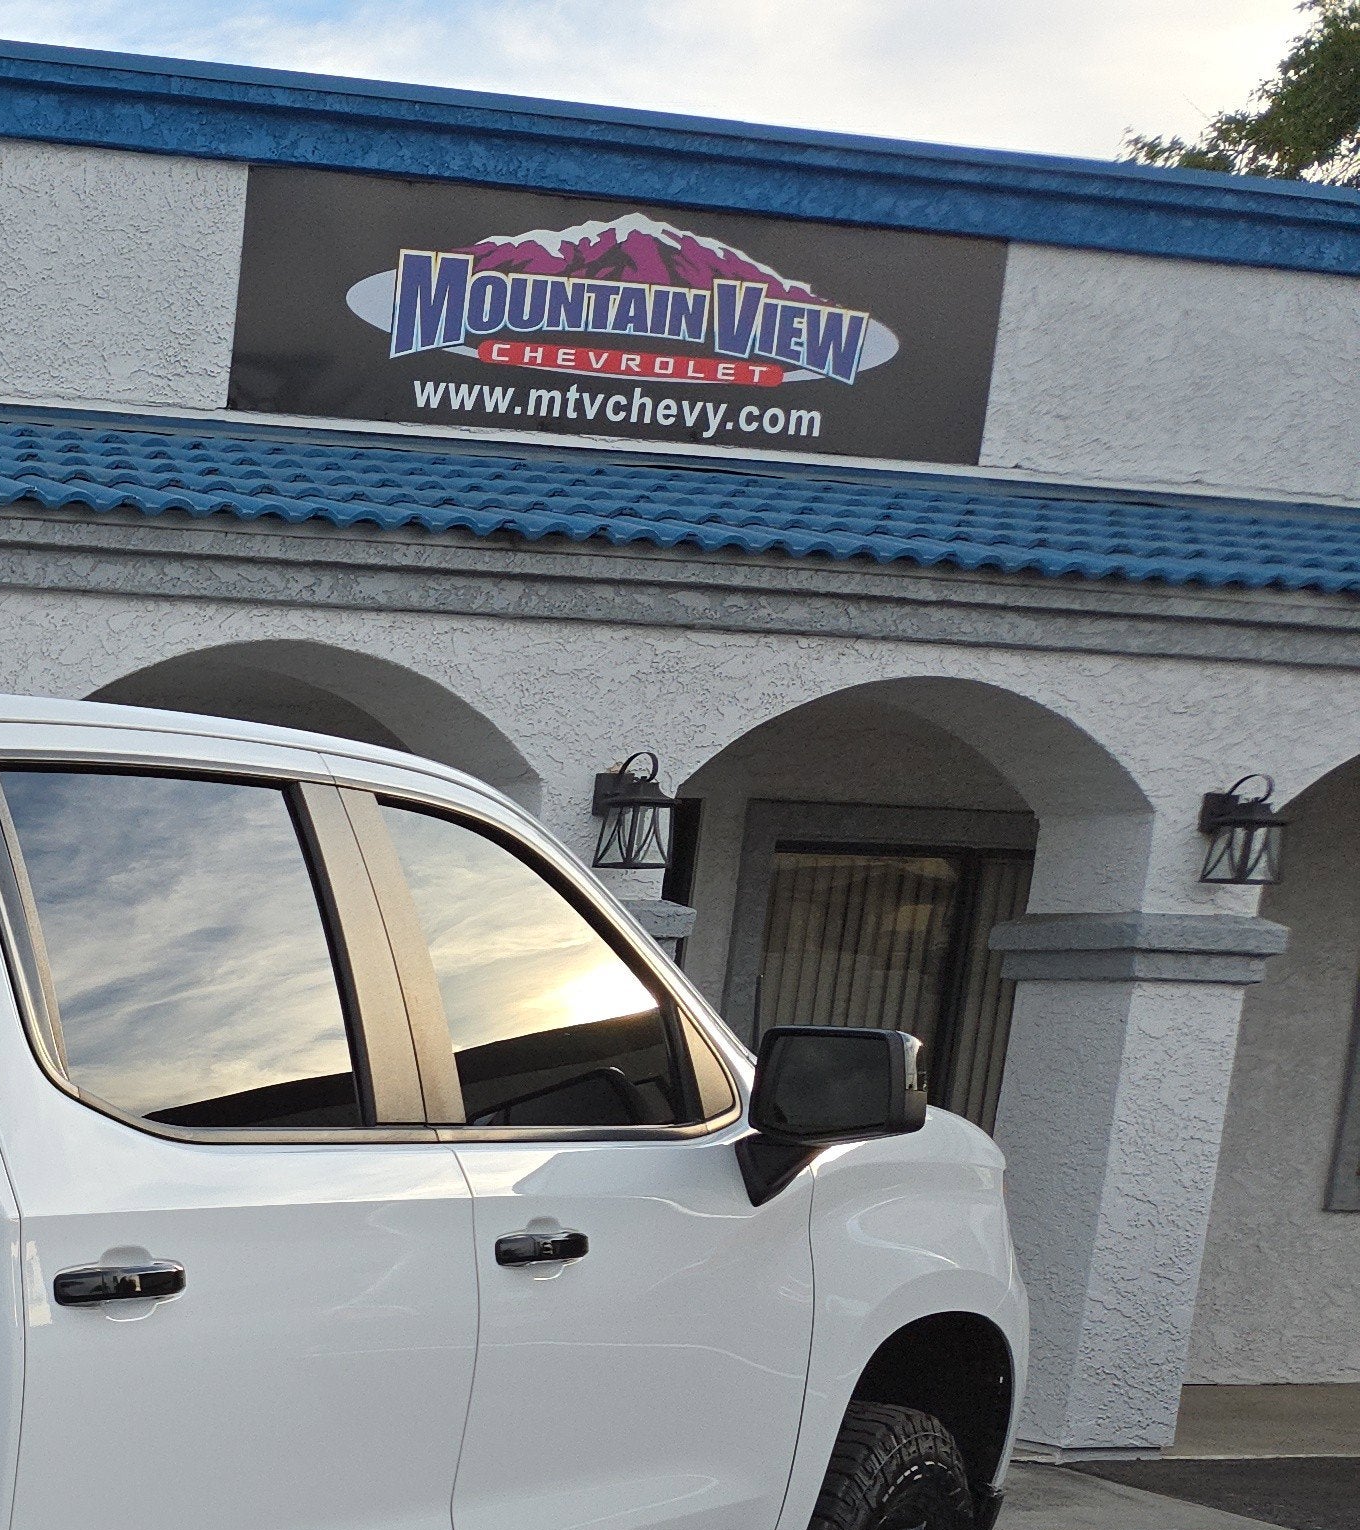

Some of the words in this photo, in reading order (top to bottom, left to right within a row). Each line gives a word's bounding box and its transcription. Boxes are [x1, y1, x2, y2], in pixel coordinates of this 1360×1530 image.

[390, 249, 711, 359] MOUNTAIN
[713, 279, 869, 385] VIEW
[491, 343, 769, 383] CHEVROLET
[413, 380, 822, 438] www.mtvchevy.com
